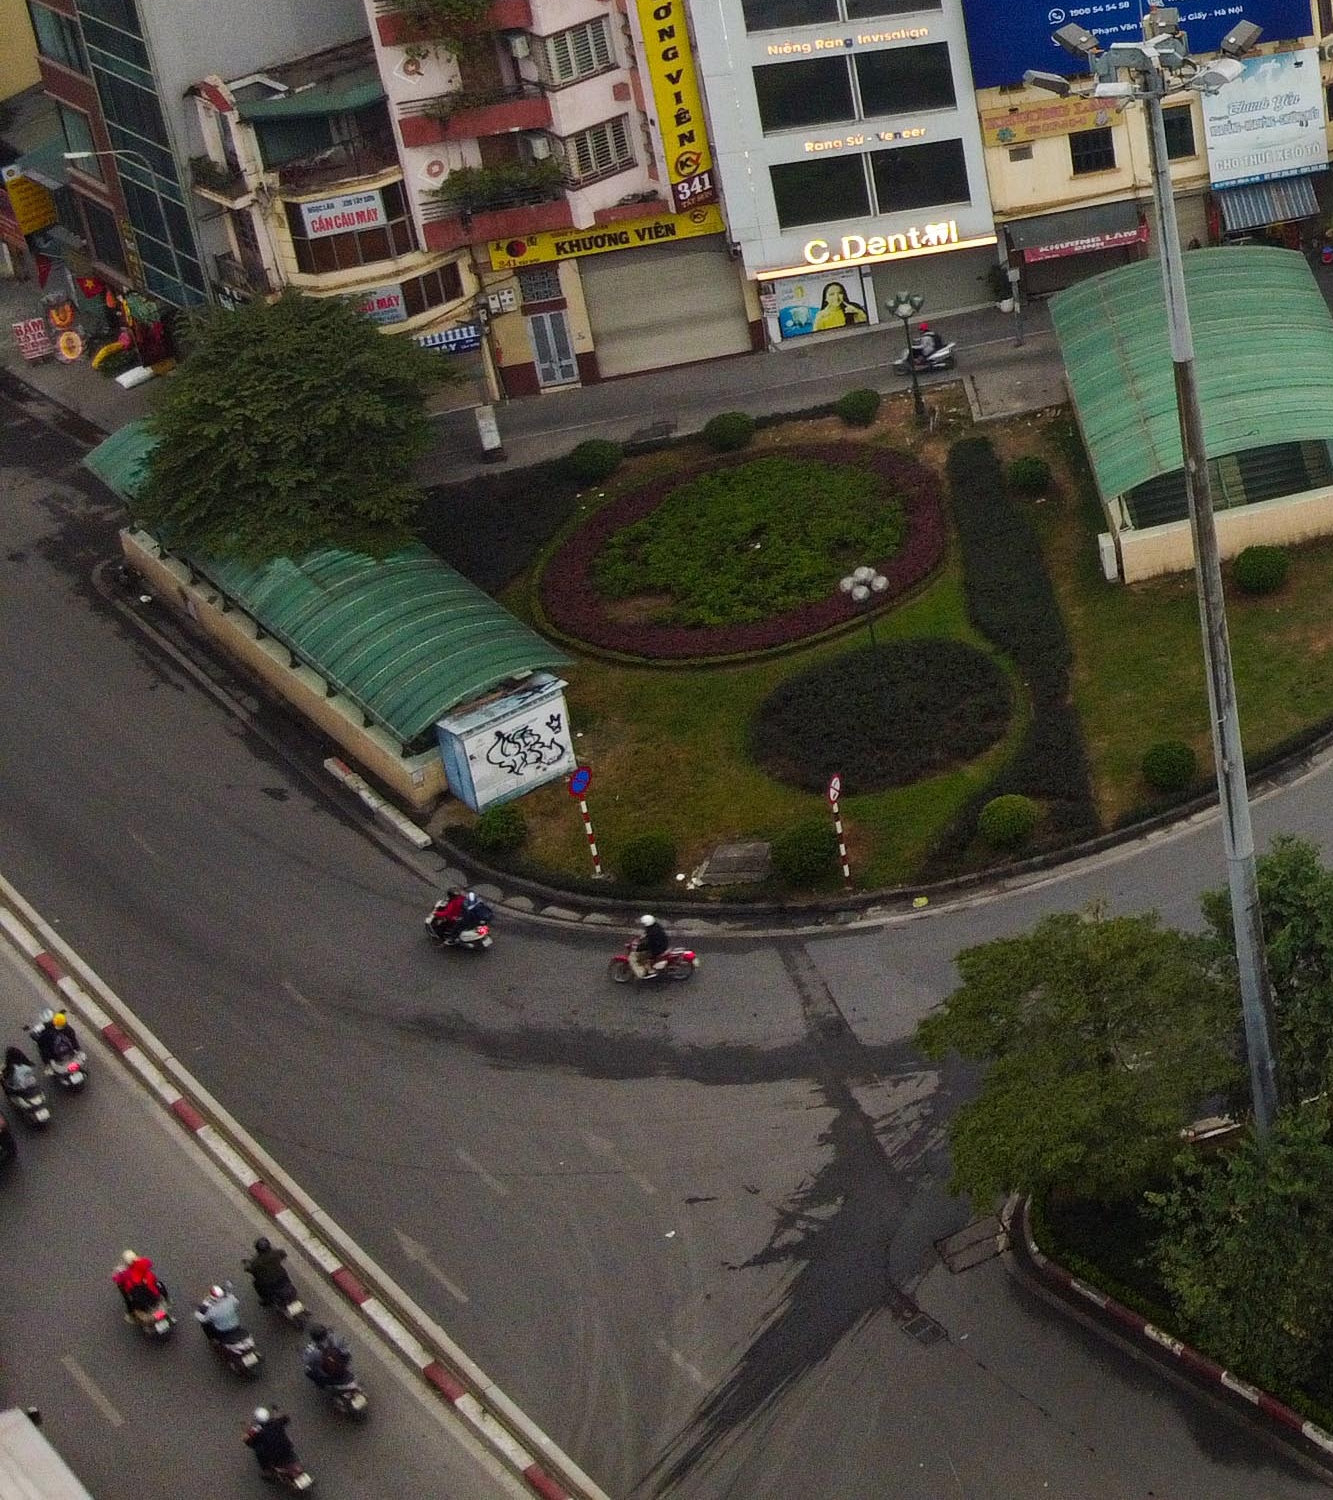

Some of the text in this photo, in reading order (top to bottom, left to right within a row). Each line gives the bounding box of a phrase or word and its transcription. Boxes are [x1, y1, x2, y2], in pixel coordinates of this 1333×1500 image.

[1214, 7, 1226, 17] Hà
[857, 26, 930, 45] Invisalign
[664, 69, 696, 148] VIÊN
[677, 172, 713, 201] 341
[355, 207, 379, 225] MÁY
[554, 230, 631, 256] KHƯƠNG
[634, 221, 677, 242] VIÊN
